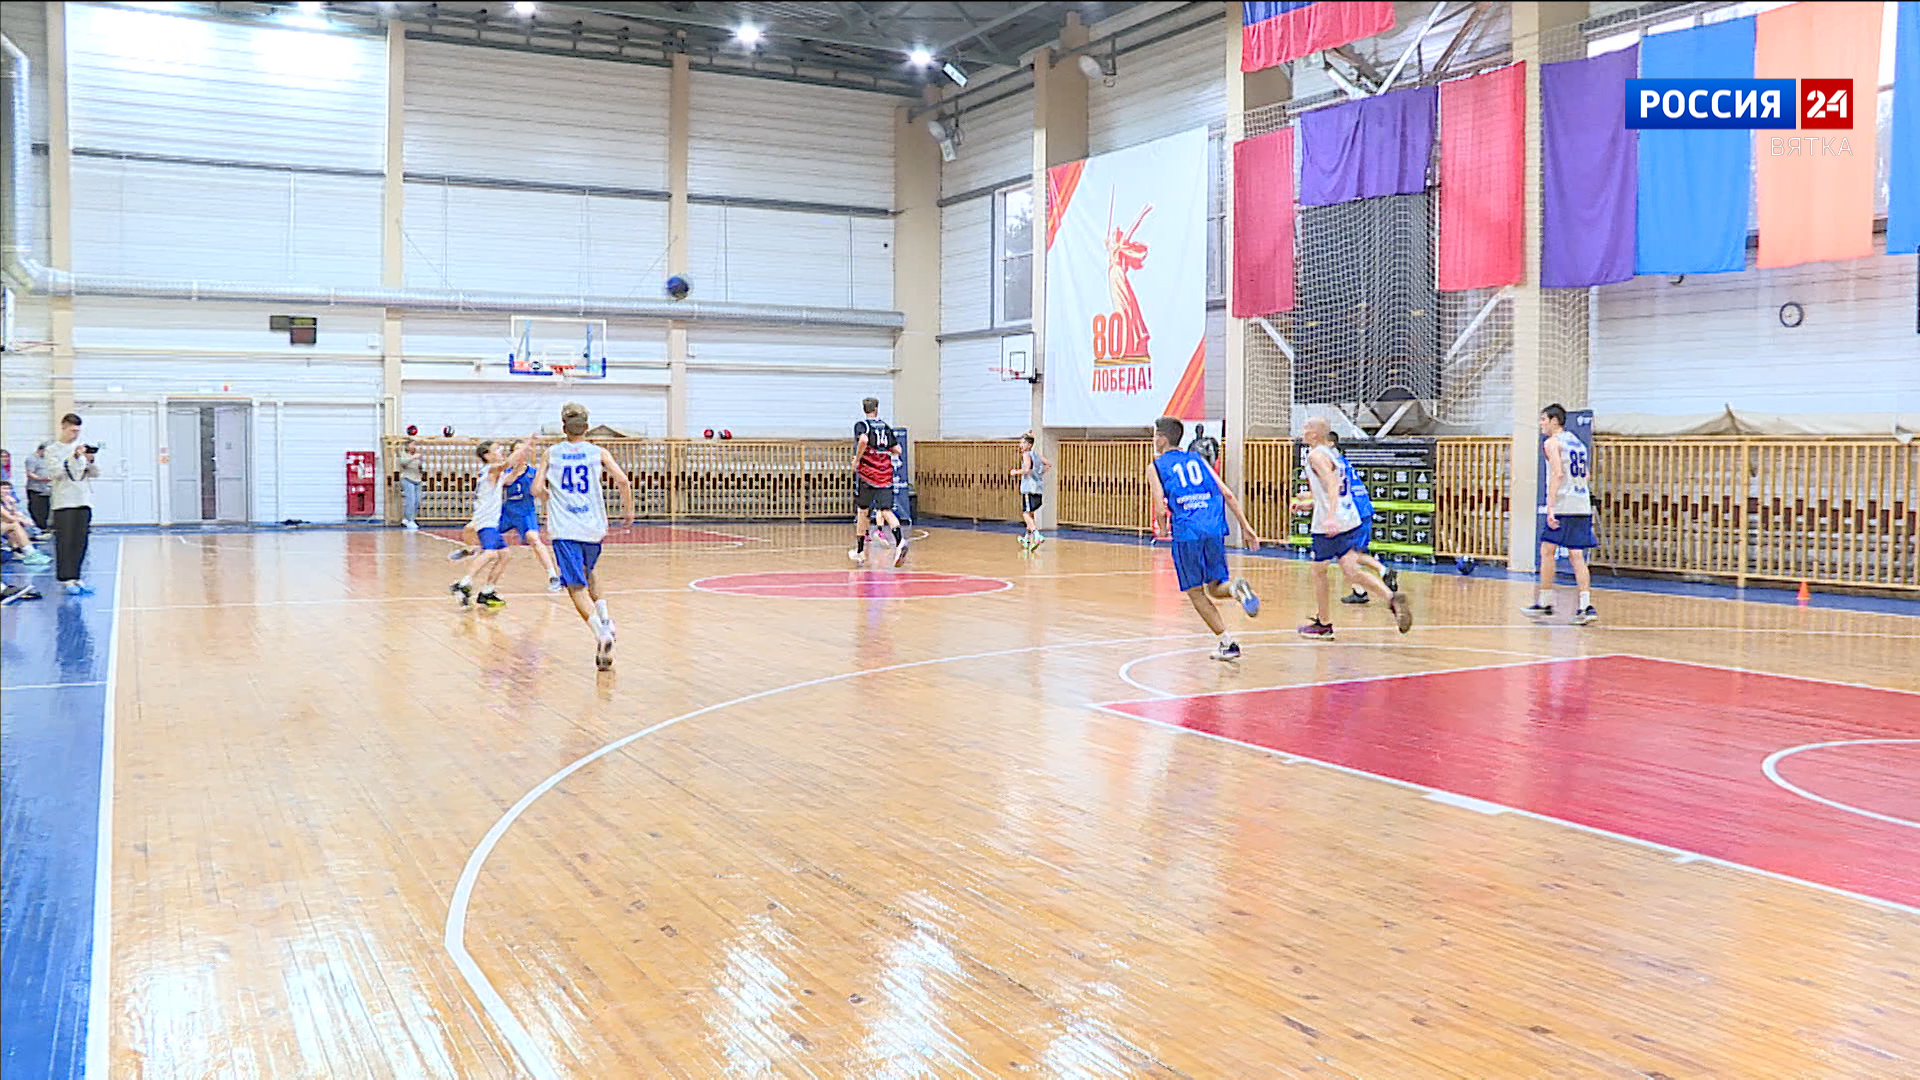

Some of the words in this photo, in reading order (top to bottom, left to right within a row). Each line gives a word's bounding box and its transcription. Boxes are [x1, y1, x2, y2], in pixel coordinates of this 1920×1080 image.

[1092, 313, 1124, 359] 80
[1092, 367, 1152, 395] ПОБЕДА!
[874, 429, 888, 448] 14
[1172, 460, 1203, 488] 10
[1570, 449, 1586, 478] 85
[561, 465, 589, 494] 43
